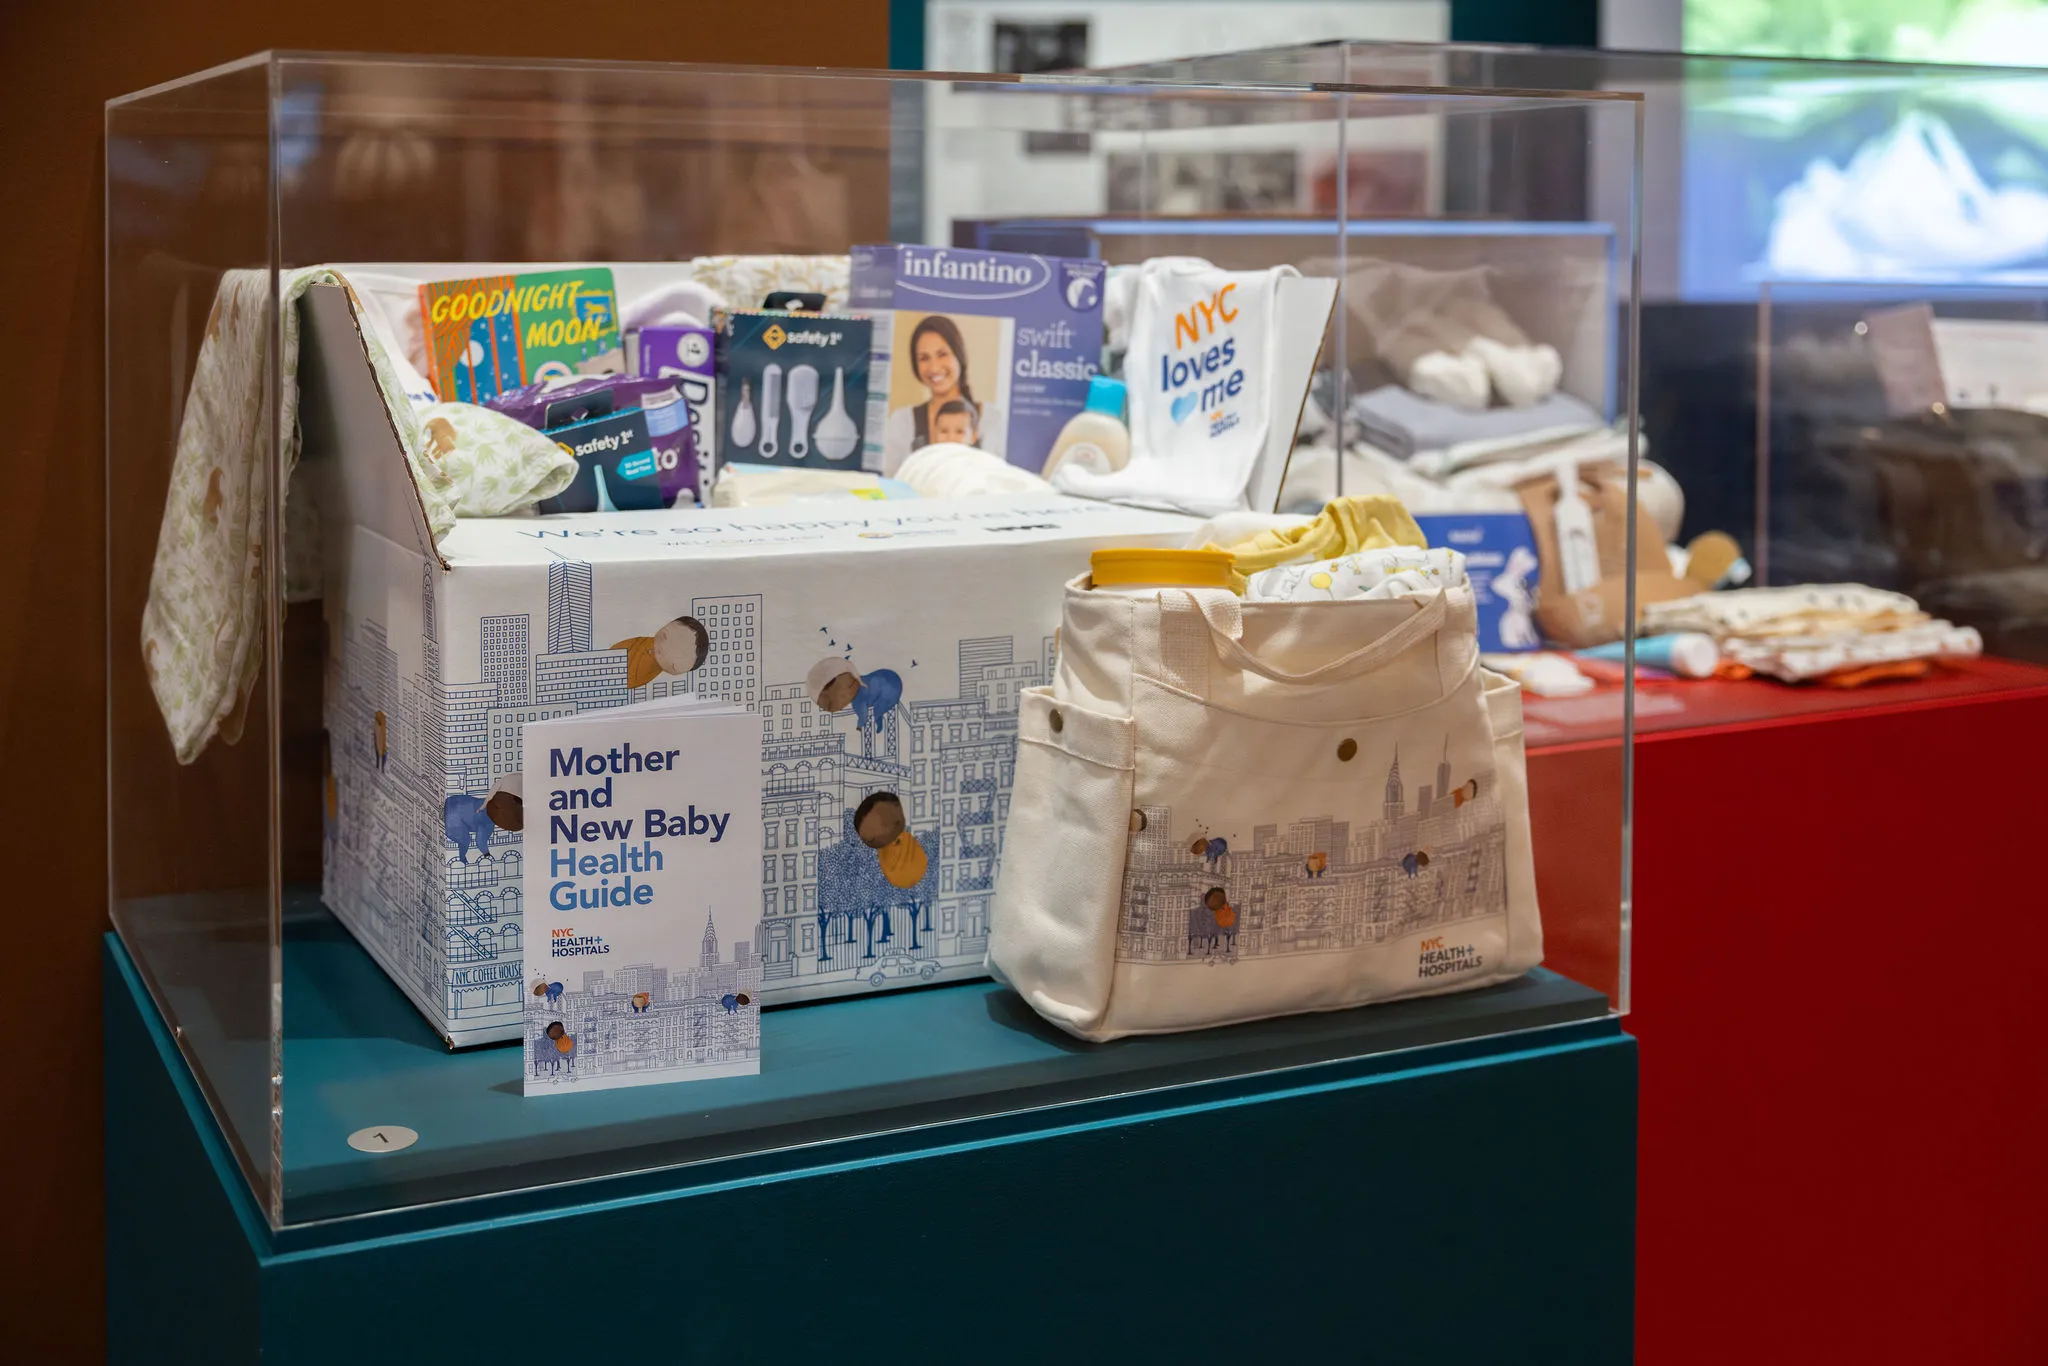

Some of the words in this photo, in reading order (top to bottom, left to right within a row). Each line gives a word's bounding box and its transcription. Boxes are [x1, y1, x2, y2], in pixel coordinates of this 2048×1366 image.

[904, 250, 1032, 285] infantino
[431, 280, 585, 324] GOODNIGHT
[1174, 283, 1239, 350] NYC
[525, 316, 603, 349] MOON
[786, 329, 829, 348] safety
[1017, 320, 1075, 349] swift
[1015, 349, 1098, 381] classic
[1161, 337, 1235, 392] loves
[1200, 369, 1244, 412] me
[575, 435, 619, 457] safety
[550, 743, 680, 777] Mother
[549, 777, 612, 810] and
[551, 814, 634, 844] New
[645, 805, 730, 842] Baby
[551, 841, 663, 878] Health
[550, 876, 653, 911] Guide
[552, 928, 574, 938] NYC
[1420, 936, 1444, 951] NYC
[552, 945, 610, 957] HOSPITALS
[1418, 955, 1483, 977] HOSPITALS
[456, 970, 471, 984] NYC
[473, 966, 497, 983] COFFEE
[499, 962, 523, 979] HOUSE
